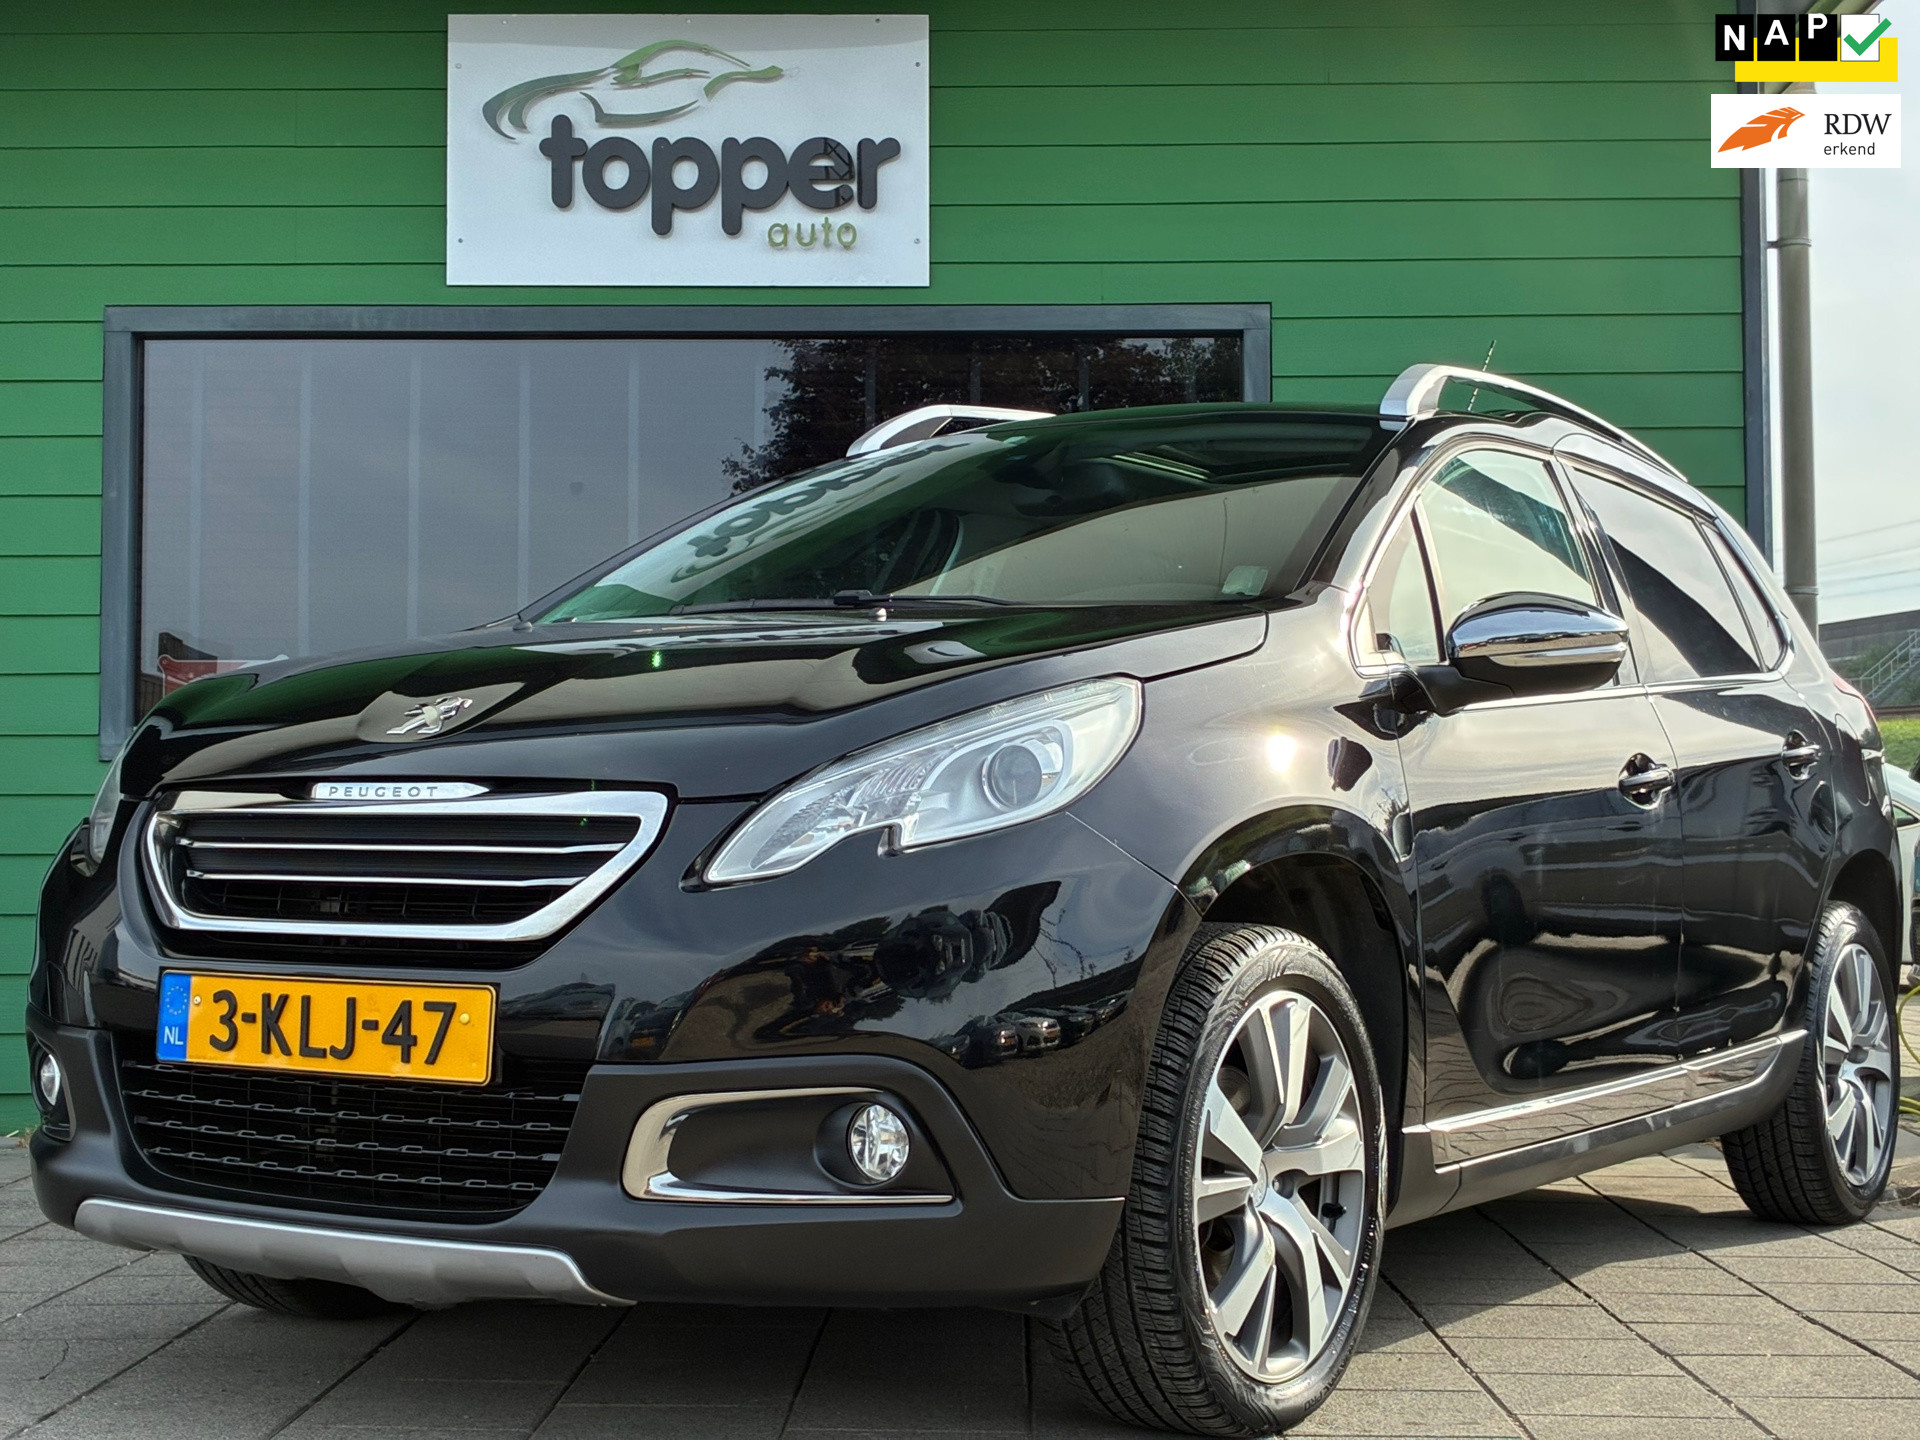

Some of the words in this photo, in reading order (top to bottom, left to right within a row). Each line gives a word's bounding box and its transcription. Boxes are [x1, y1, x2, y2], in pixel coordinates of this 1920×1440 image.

[539, 114, 901, 236] topper
[767, 217, 858, 249] auto
[329, 786, 438, 798] PEUGEOT
[163, 1027, 184, 1046] NL
[208, 988, 458, 1066] 3-KLJ-47
